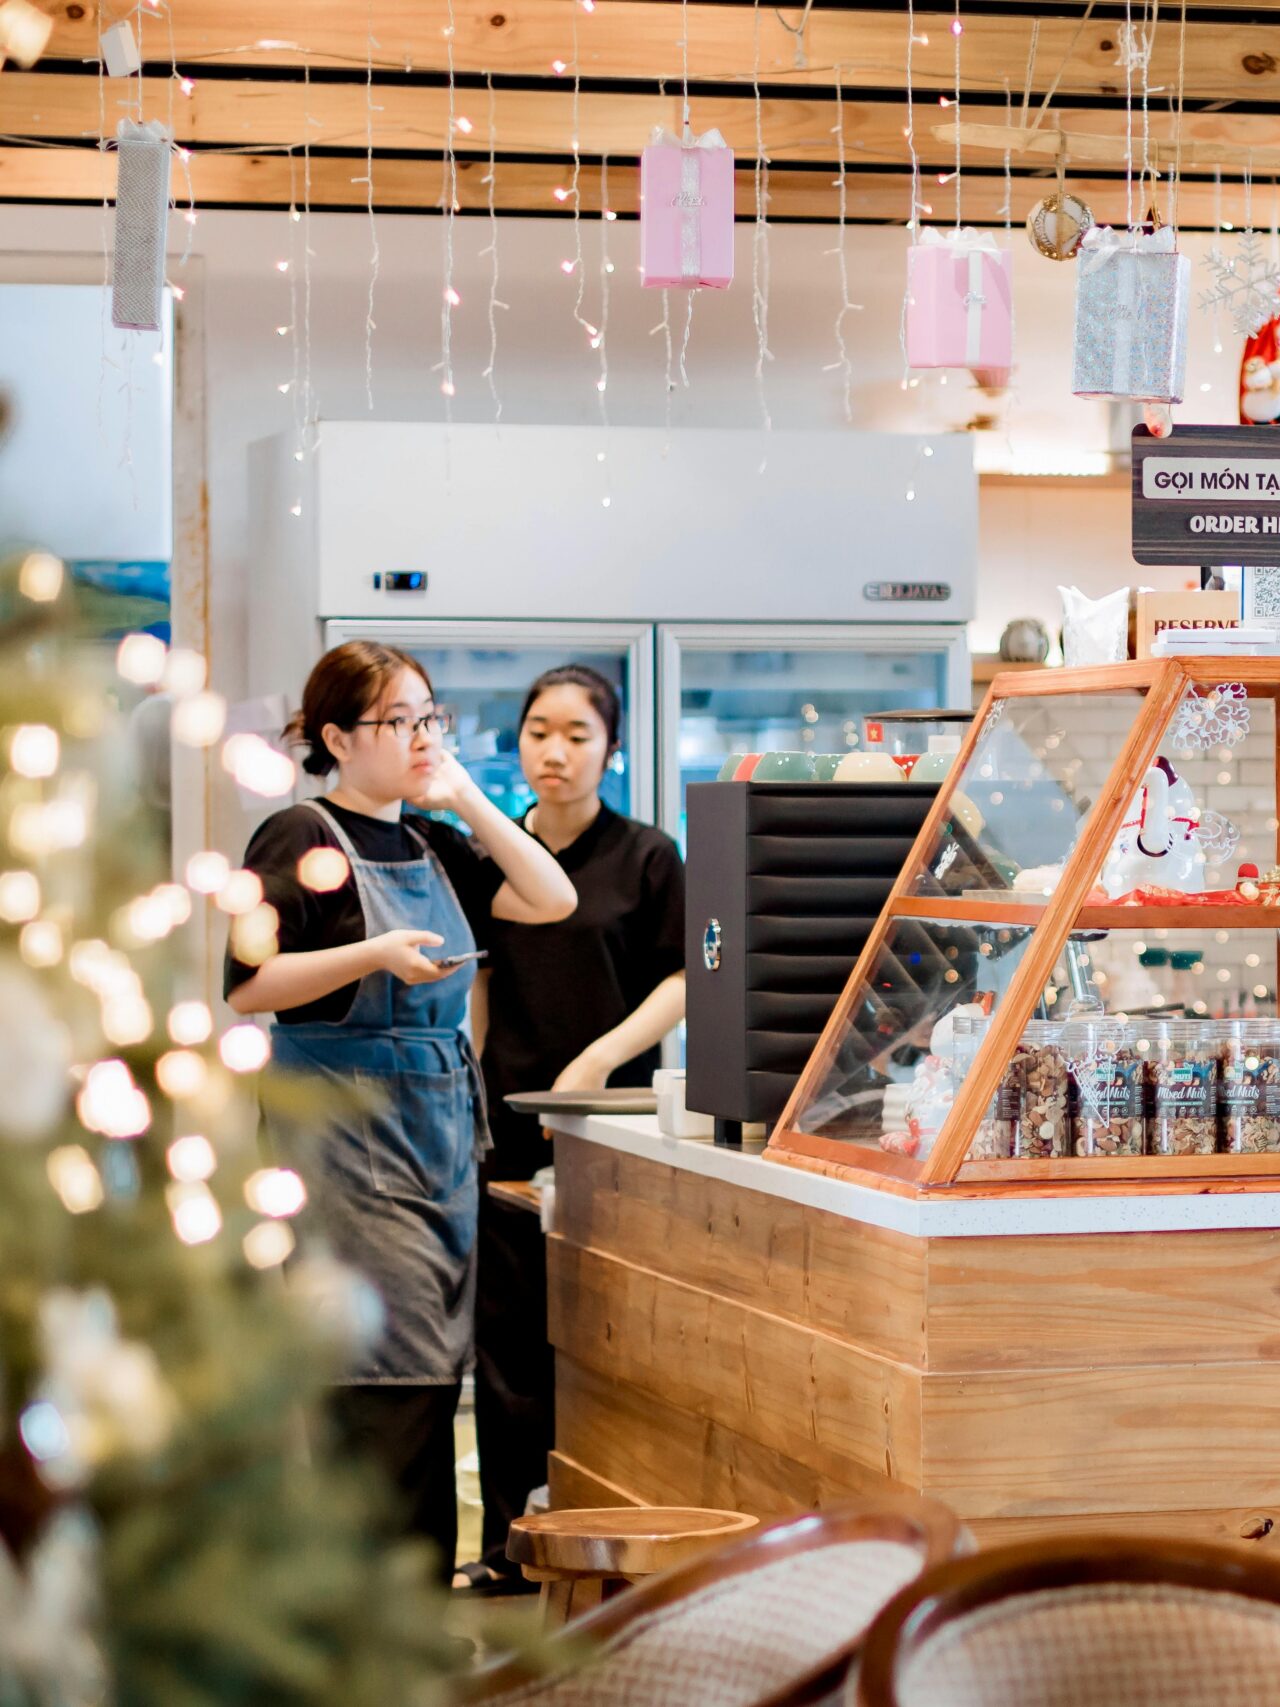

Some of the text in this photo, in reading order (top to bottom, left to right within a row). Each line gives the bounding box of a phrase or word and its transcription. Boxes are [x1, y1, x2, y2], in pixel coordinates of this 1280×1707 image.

[1154, 471, 1194, 494] GỌI
[1200, 467, 1249, 490] MÓN
[1190, 516, 1259, 533] ORDER
[1109, 1086, 1130, 1100] Nuts
[1157, 1085, 1207, 1100] Mixed Nuts
[1239, 1085, 1260, 1099] Nuts
